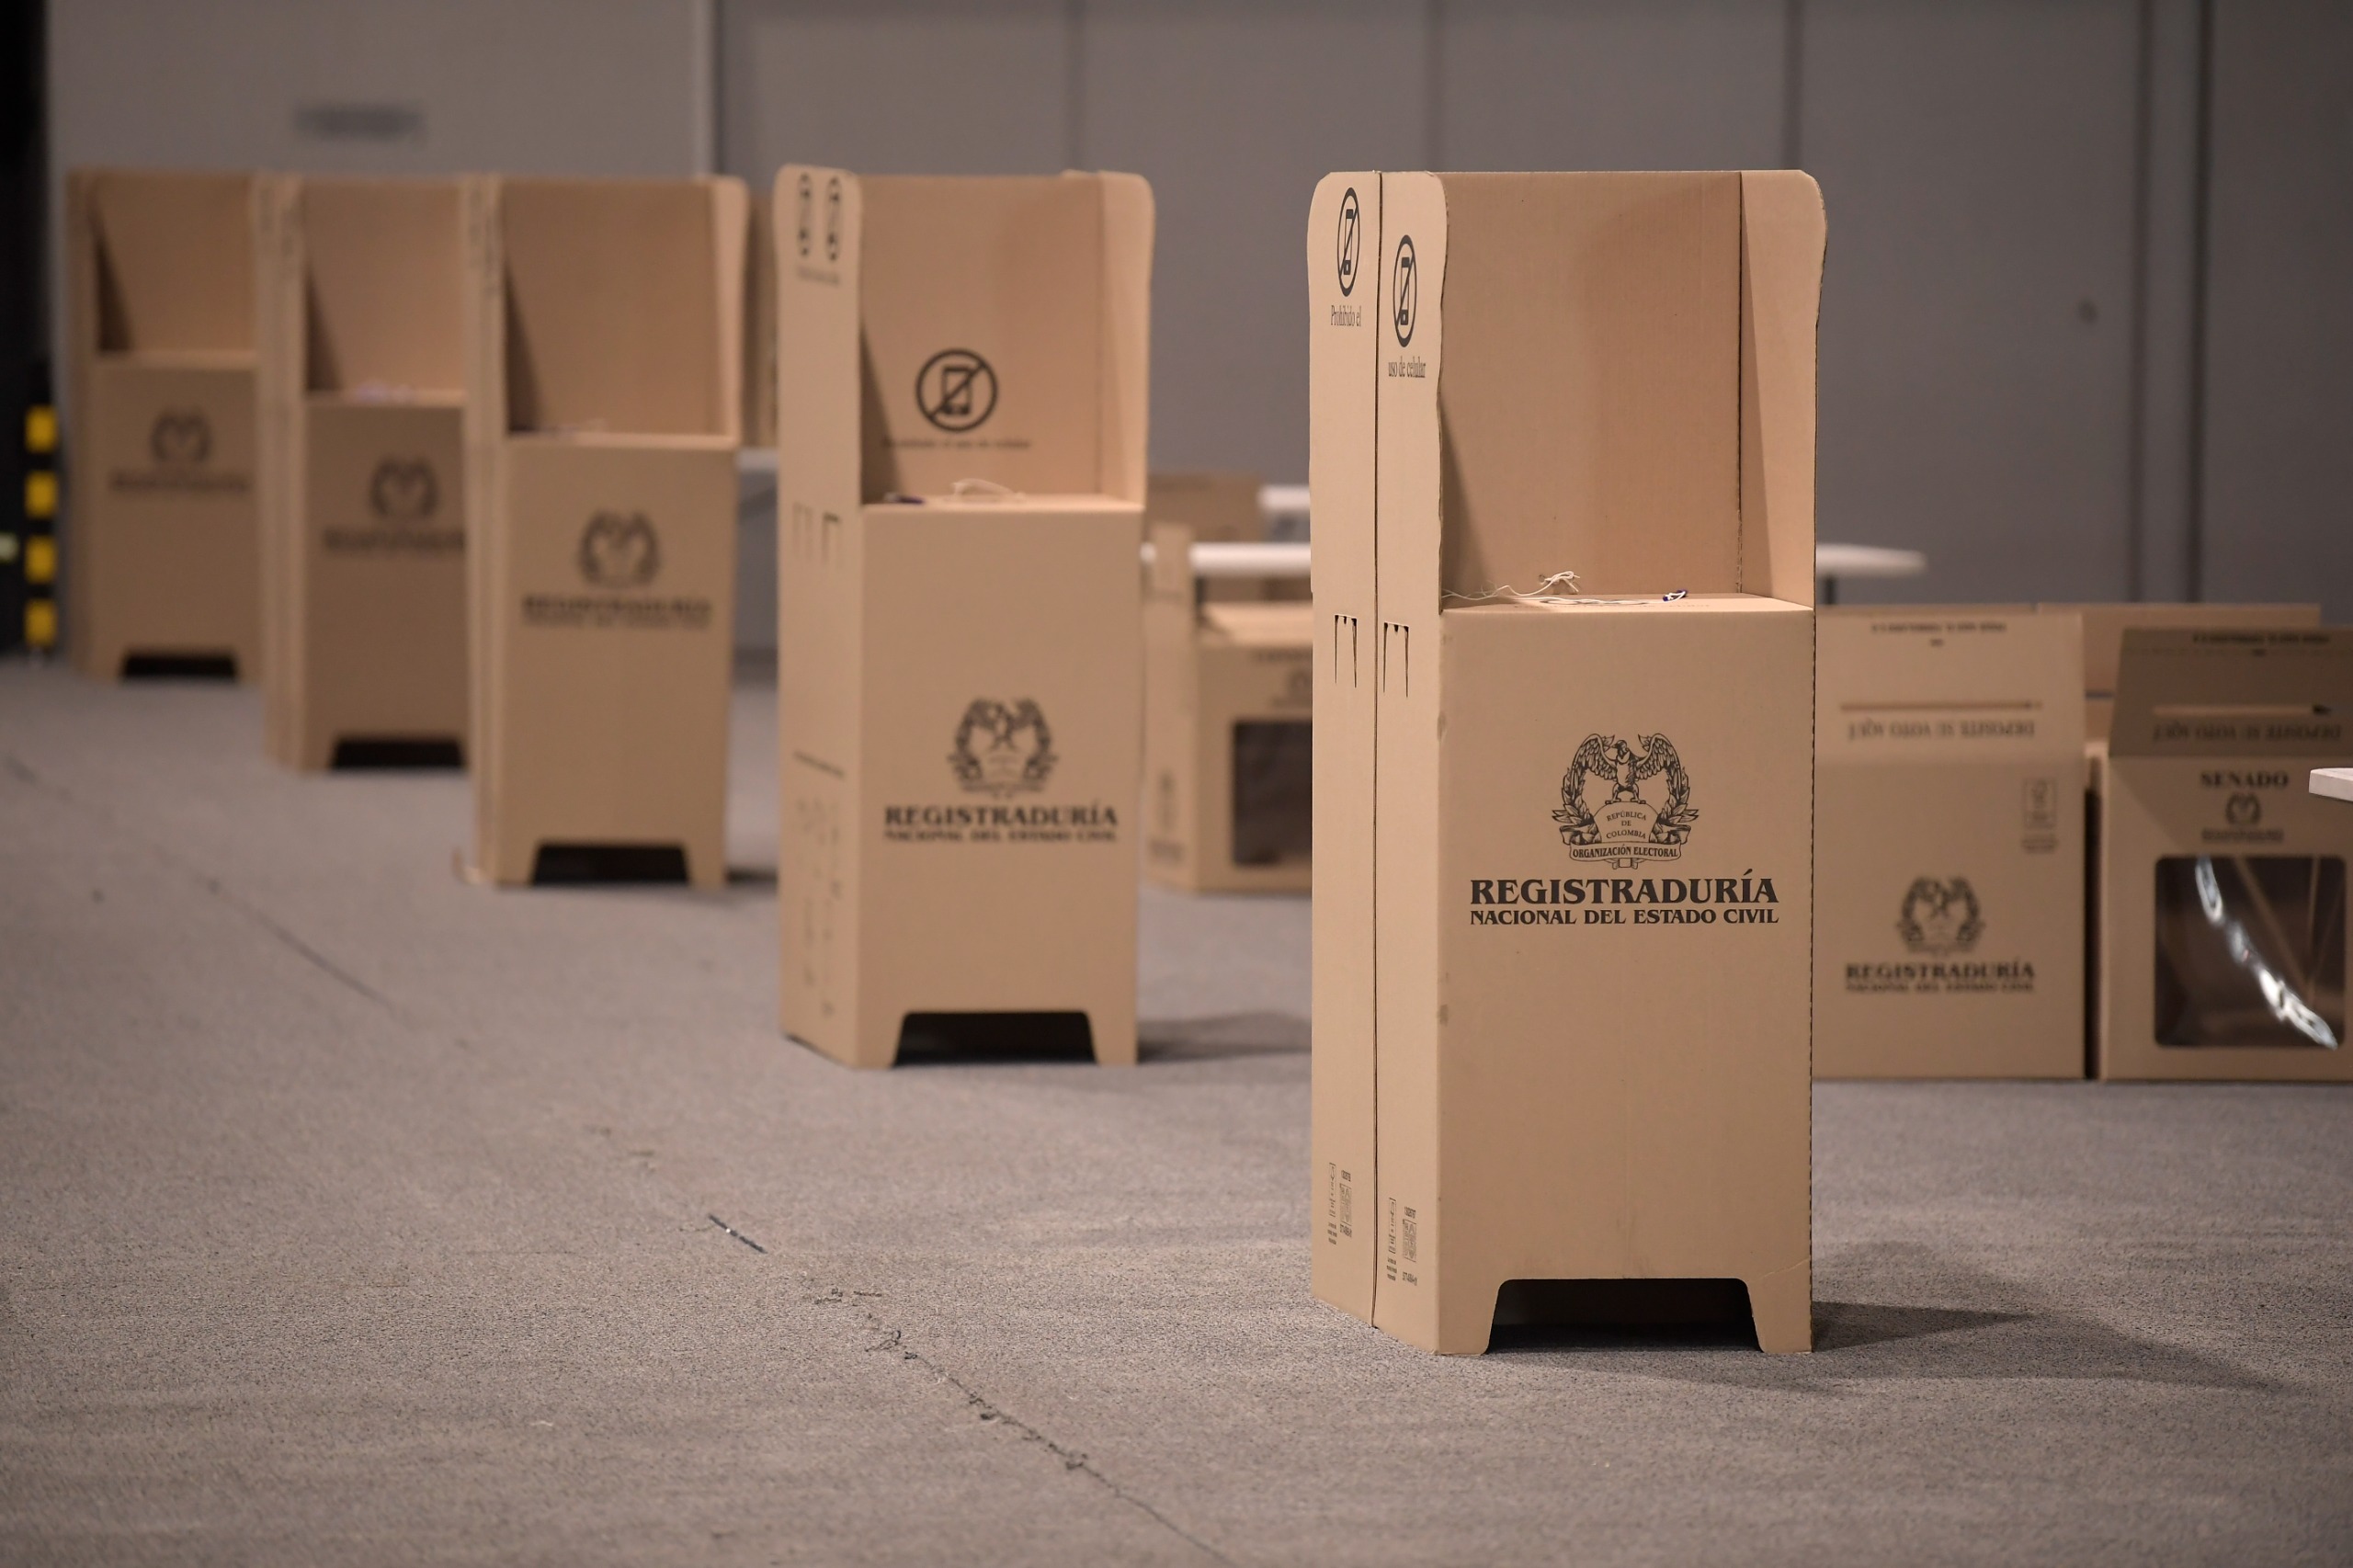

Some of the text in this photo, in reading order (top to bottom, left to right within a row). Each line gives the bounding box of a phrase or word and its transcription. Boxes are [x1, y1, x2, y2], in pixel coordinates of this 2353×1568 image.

[1388, 362, 1398, 378] uso
[1399, 356, 1406, 378] de
[2200, 770, 2290, 789] SENADO
[885, 799, 1119, 827] REGISTRADURÍA
[1607, 810, 1646, 822] REPÚBLICA
[1606, 829, 1646, 839] COLOMBIA
[1573, 844, 1678, 858] ORGANIZACIÓN ELECTORAL
[1471, 869, 1779, 904] REGISTRADURÍA
[1471, 908, 1779, 926] NACIONAL DEL ESTADO CIVIL
